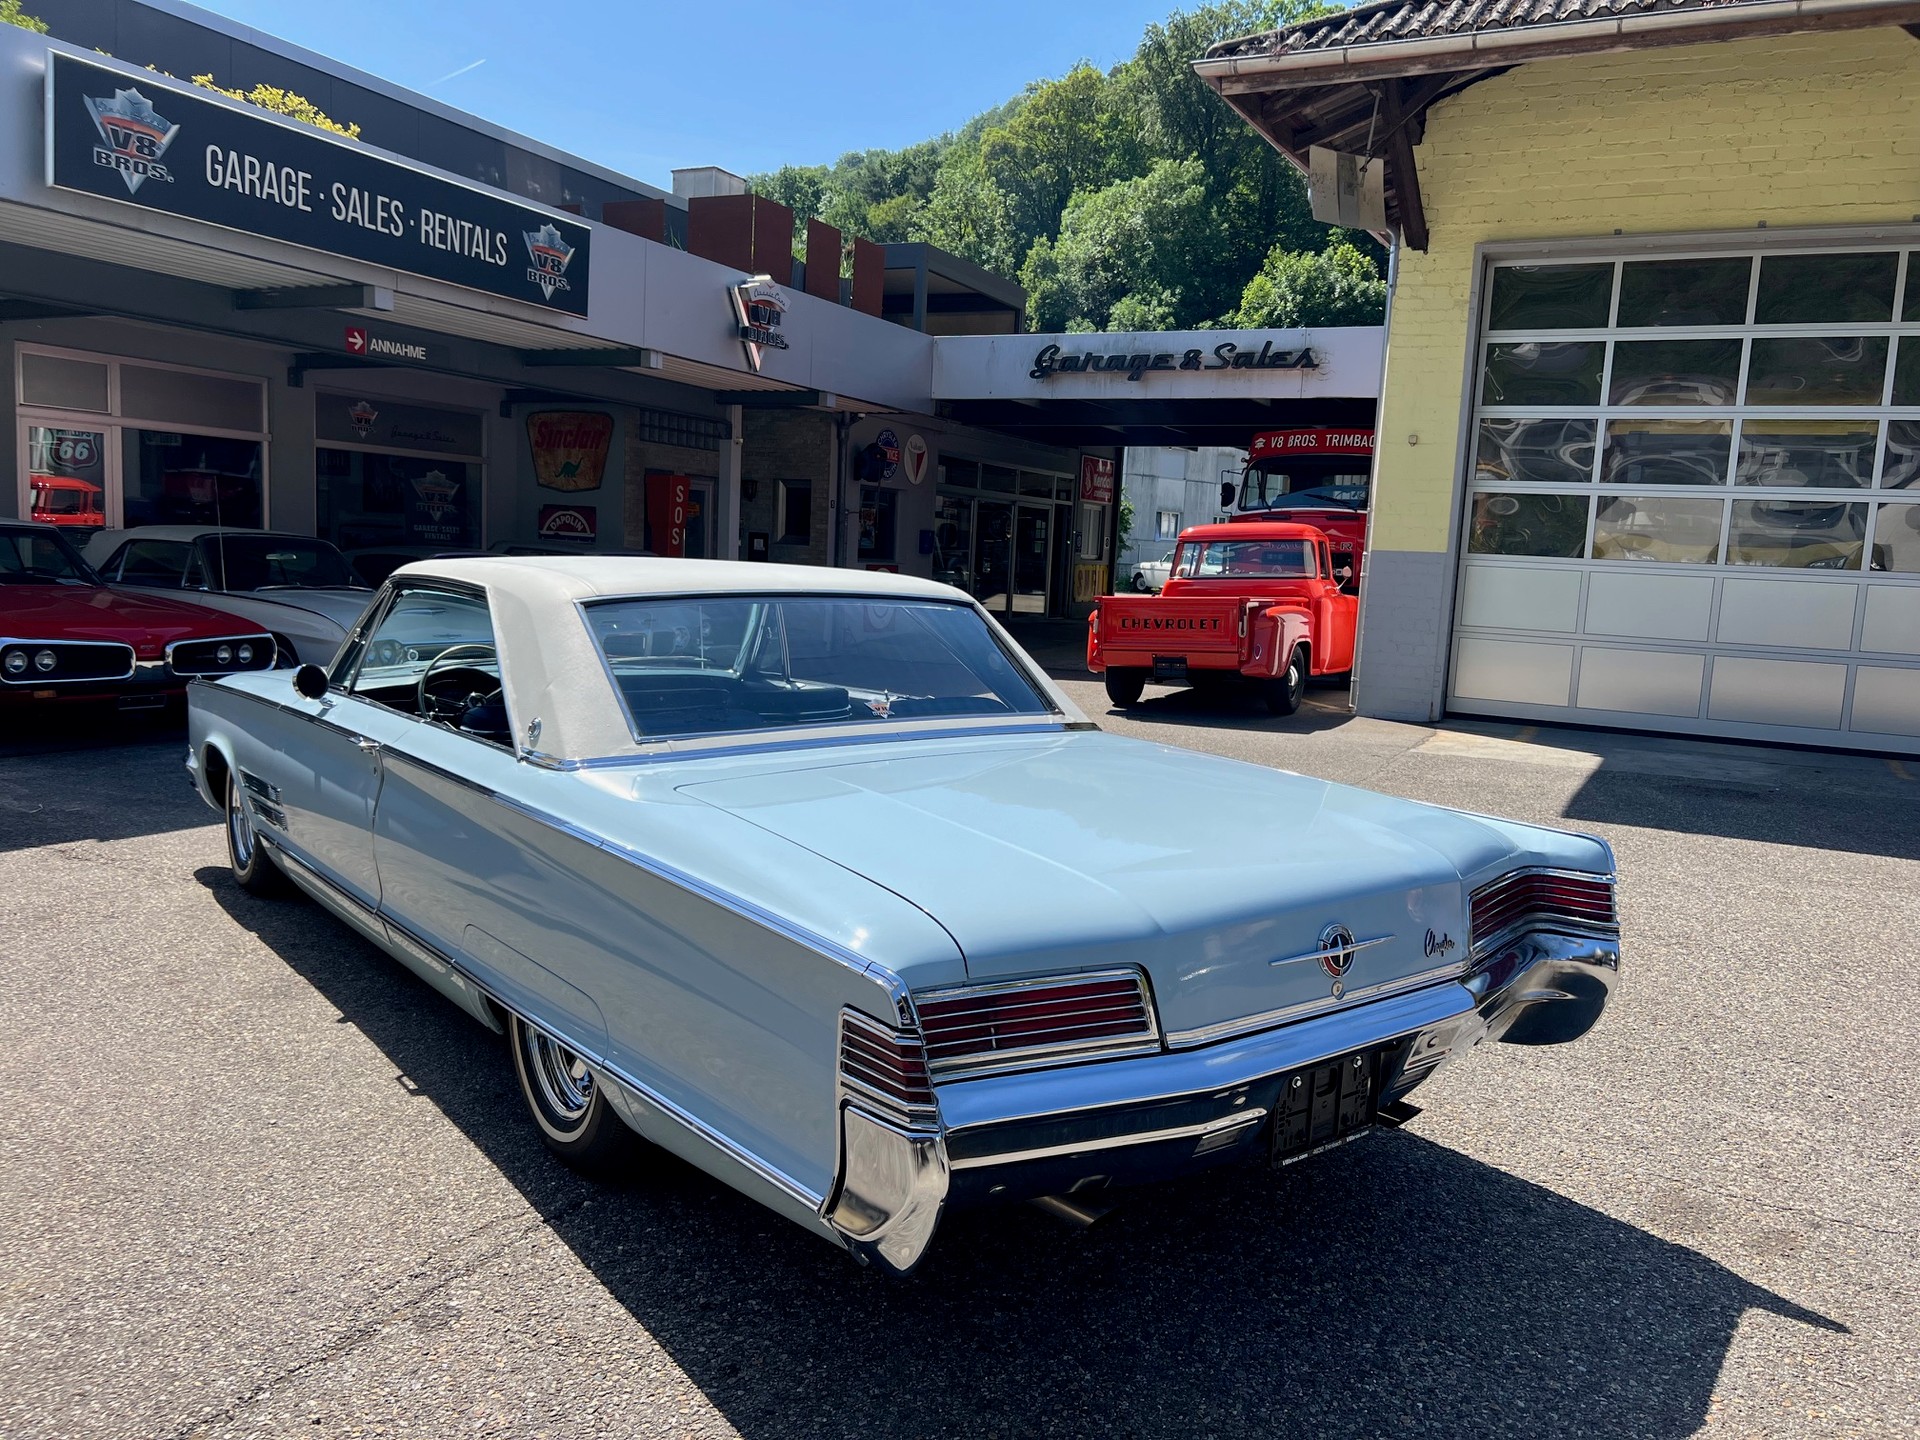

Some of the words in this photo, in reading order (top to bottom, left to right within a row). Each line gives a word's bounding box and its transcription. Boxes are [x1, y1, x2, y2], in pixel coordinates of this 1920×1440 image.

[107, 123, 158, 159] V8
[93, 146, 174, 183] BROS.
[205, 144, 312, 213] GARAGE
[331, 182, 404, 237] SALES
[420, 208, 507, 266] RENTALS
[535, 250, 563, 275] V8
[527, 267, 571, 291] BROS.
[753, 304, 781, 326] V8
[370, 338, 427, 360] ANNAHME
[1029, 344, 1176, 381] Garage
[1179, 349, 1202, 371] &
[1204, 341, 1319, 371] Sales
[535, 421, 606, 450] Sinclair
[1271, 436, 1284, 449] V8
[1287, 435, 1318, 448] BROS.
[59, 441, 90, 460] 66
[549, 515, 584, 531] DAPOLIN
[1121, 618, 1220, 630] CHEVROLET
